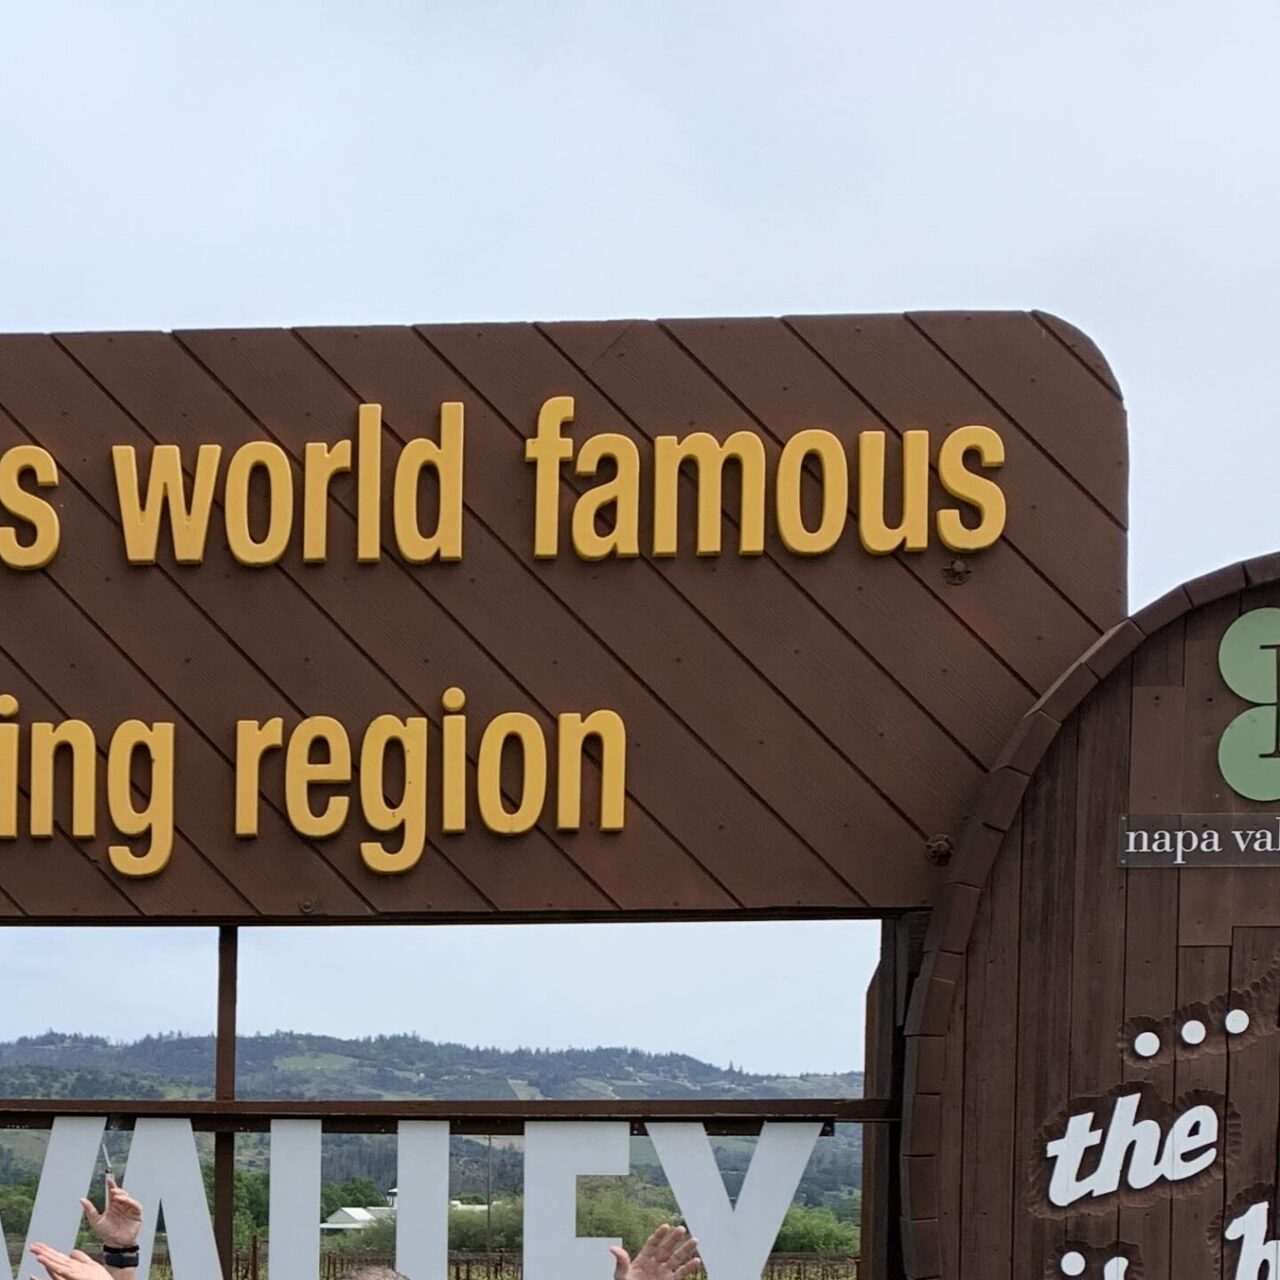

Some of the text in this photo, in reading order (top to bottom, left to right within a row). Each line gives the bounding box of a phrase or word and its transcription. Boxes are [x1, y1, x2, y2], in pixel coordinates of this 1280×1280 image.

[112, 401, 465, 566] world
[525, 396, 1007, 560] famous
[235, 687, 627, 874] region
[1125, 829, 1223, 864] napa
[1046, 1092, 1218, 1207] the
